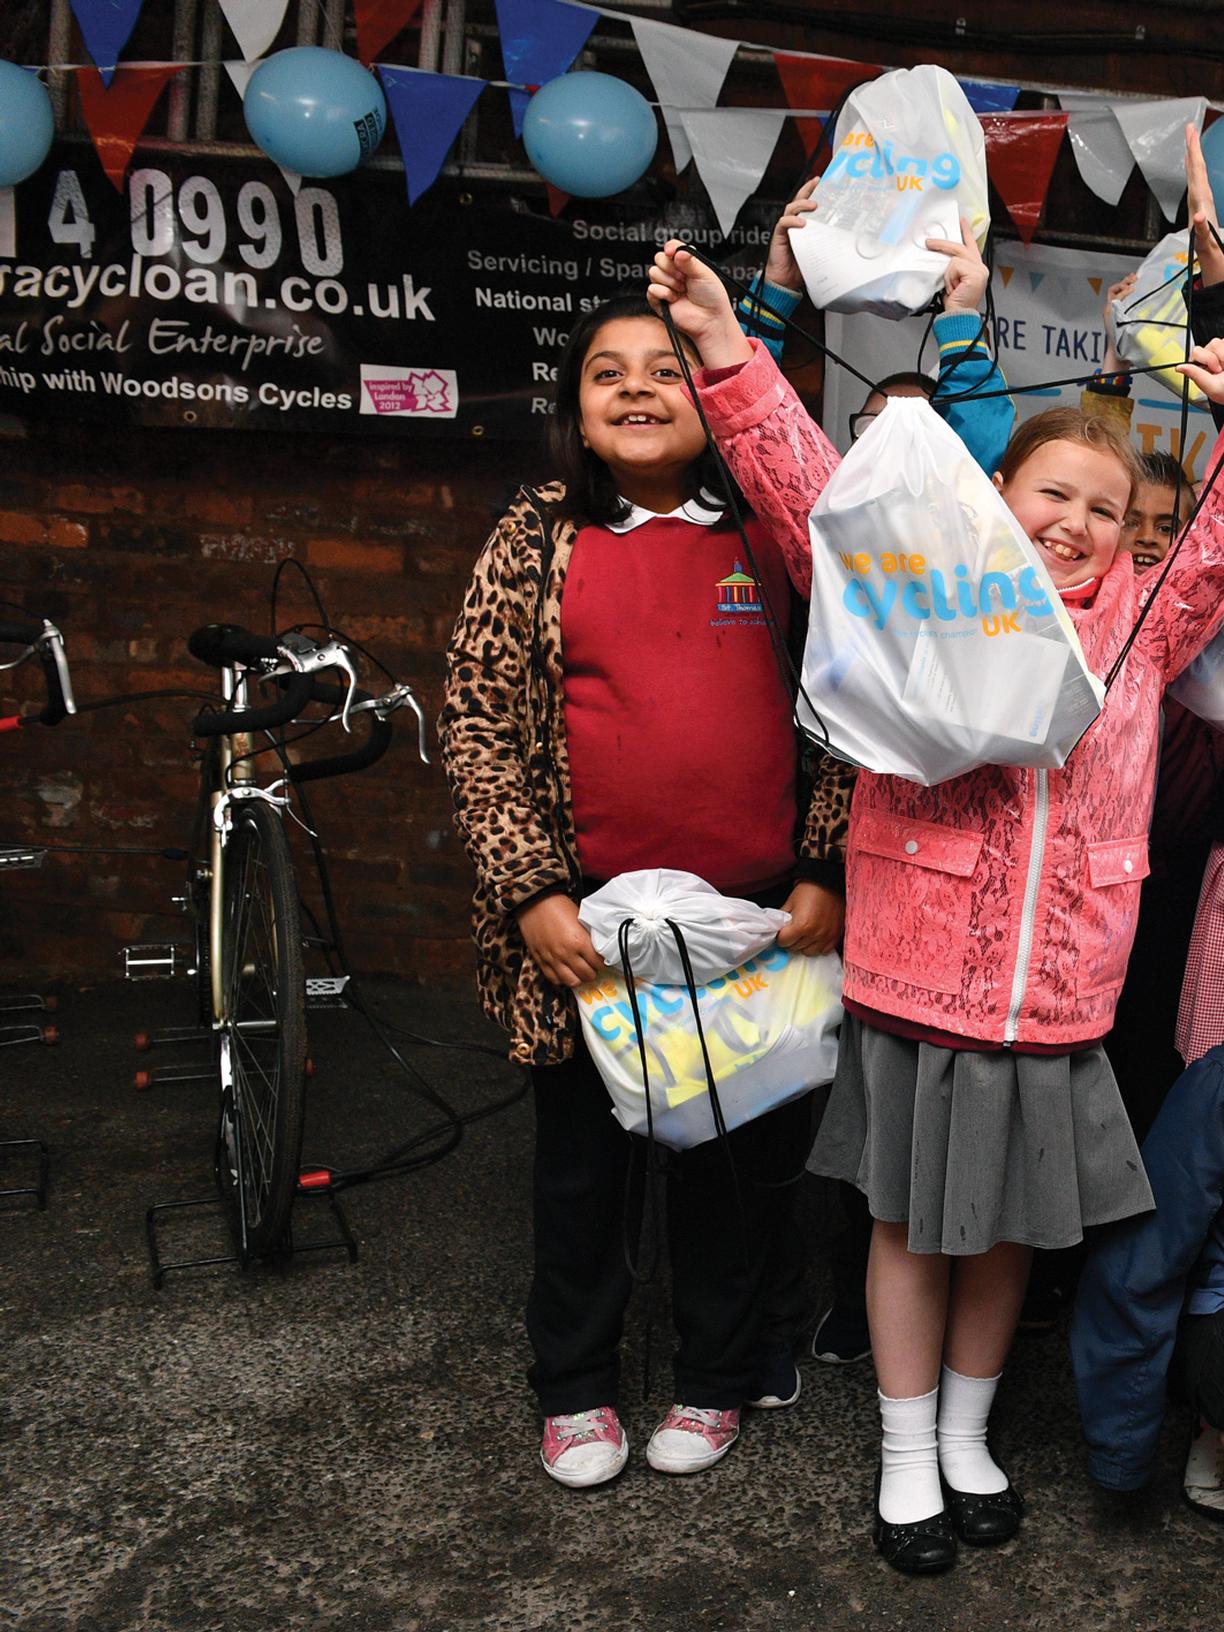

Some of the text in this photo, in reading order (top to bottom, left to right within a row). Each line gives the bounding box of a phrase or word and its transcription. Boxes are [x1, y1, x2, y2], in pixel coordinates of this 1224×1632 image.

[895, 175, 923, 193] UK
[129, 168, 344, 277] 0990
[573, 219, 646, 242] Social
[654, 225, 722, 248] group
[467, 250, 579, 280] Servicing
[475, 287, 573, 312] National
[40, 314, 133, 356] Social
[148, 318, 324, 371] Enterprise
[41, 368, 97, 393] with
[100, 371, 249, 403] Woodsons
[258, 382, 352, 411] Cycles
[374, 391, 406, 401] London
[380, 401, 401, 410] 2012
[880, 552, 926, 575] are
[843, 564, 1054, 631] cycling
[982, 612, 1022, 637] UK
[578, 979, 618, 1005] we
[735, 972, 769, 999] UK
